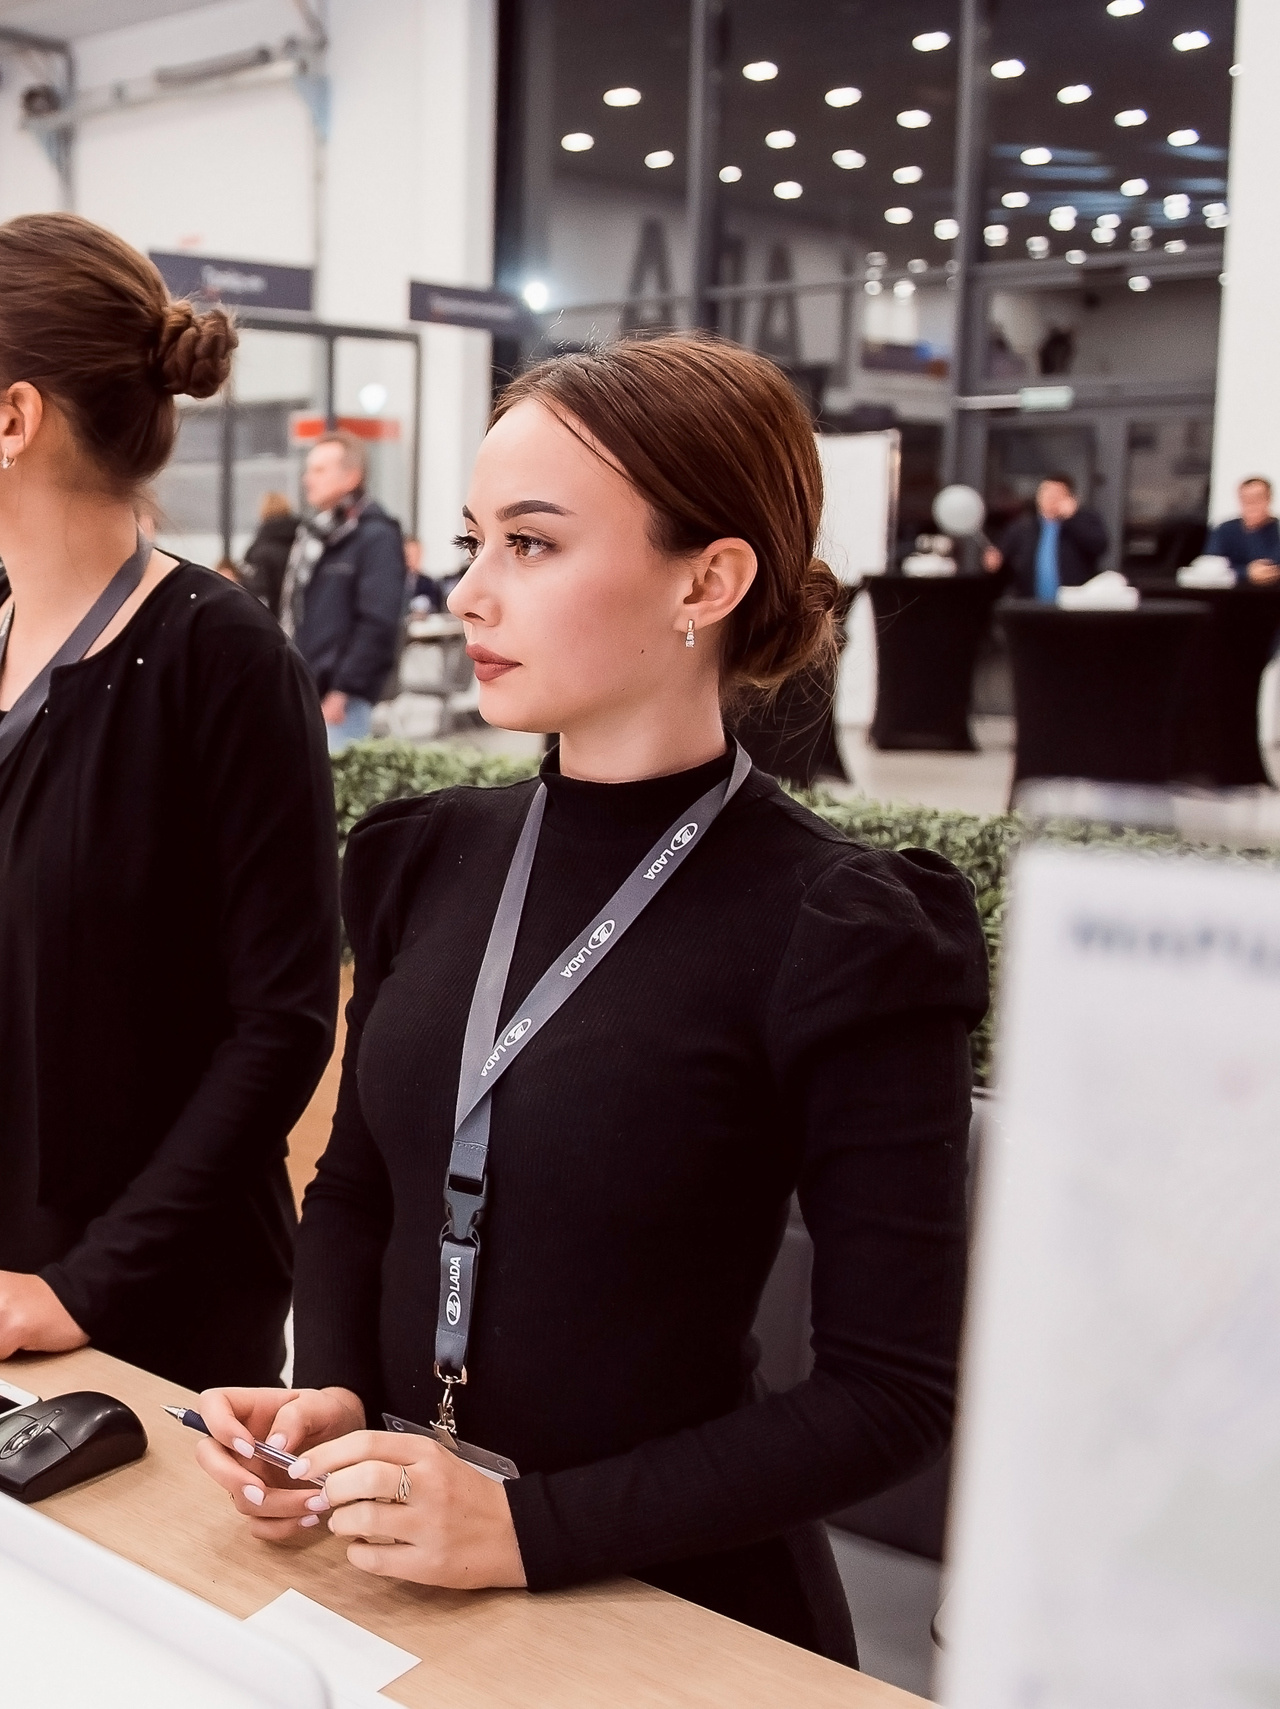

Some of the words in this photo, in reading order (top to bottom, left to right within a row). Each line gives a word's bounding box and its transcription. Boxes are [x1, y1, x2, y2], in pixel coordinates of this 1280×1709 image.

[643, 850, 675, 880] LADA
[560, 947, 593, 979] LADA
[481, 1045, 506, 1076] LADA
[450, 1257, 461, 1291] LADA
